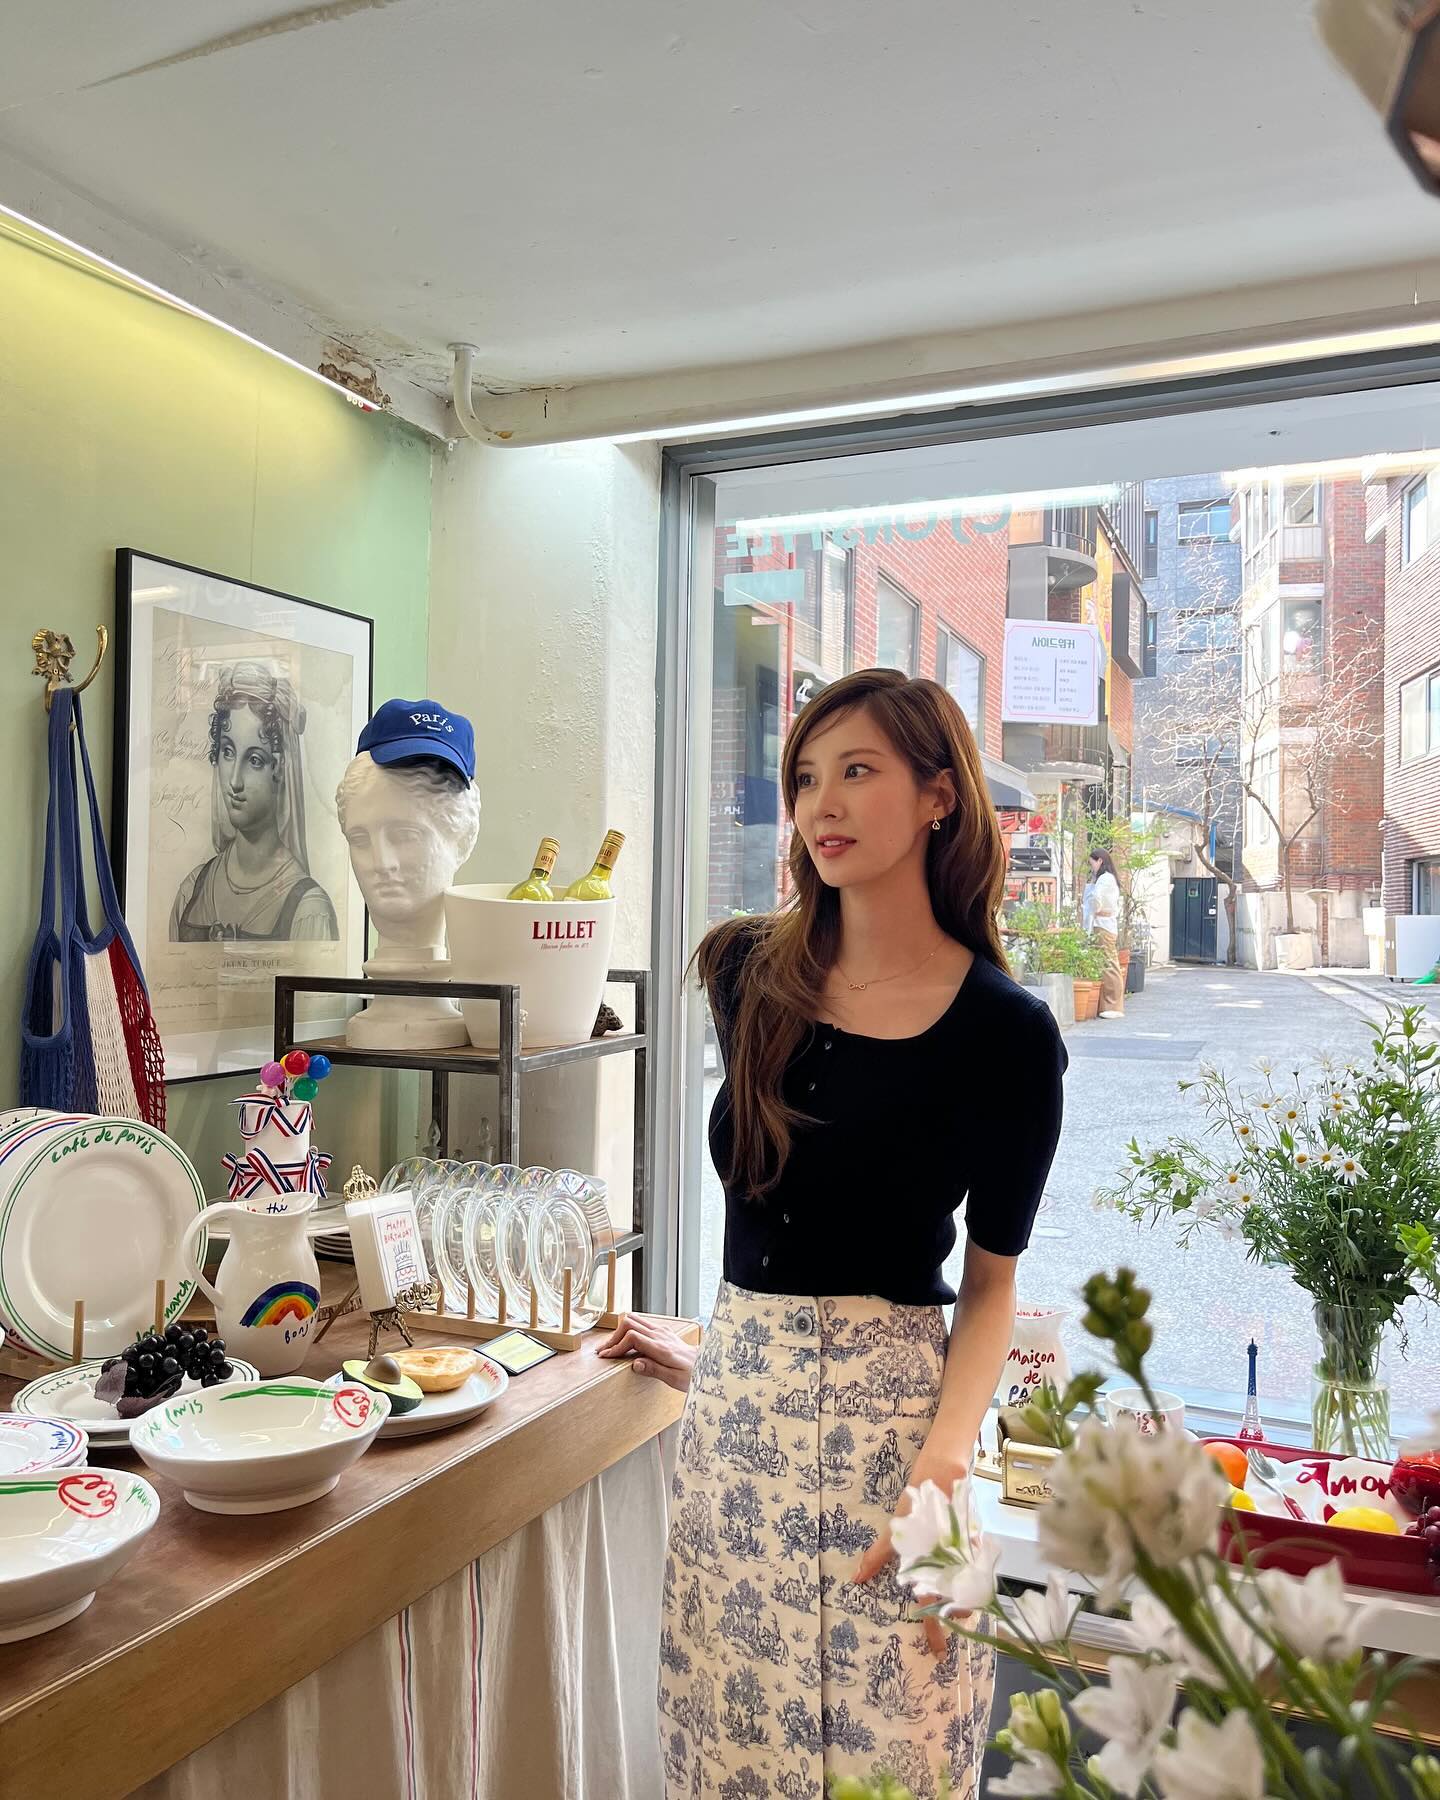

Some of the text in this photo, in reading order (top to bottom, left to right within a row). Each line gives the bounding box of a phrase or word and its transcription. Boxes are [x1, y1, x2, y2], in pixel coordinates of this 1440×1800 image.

[409, 713, 455, 733] Paris
[1031, 881, 1053, 896] EAT
[532, 920, 597, 940] LILLET
[94, 1128, 114, 1144] de
[386, 1219, 407, 1231] HAPPY
[384, 1229, 412, 1244] BIRTHDAY
[1007, 1348, 1055, 1369] Maison
[1023, 1369, 1042, 1385] de
